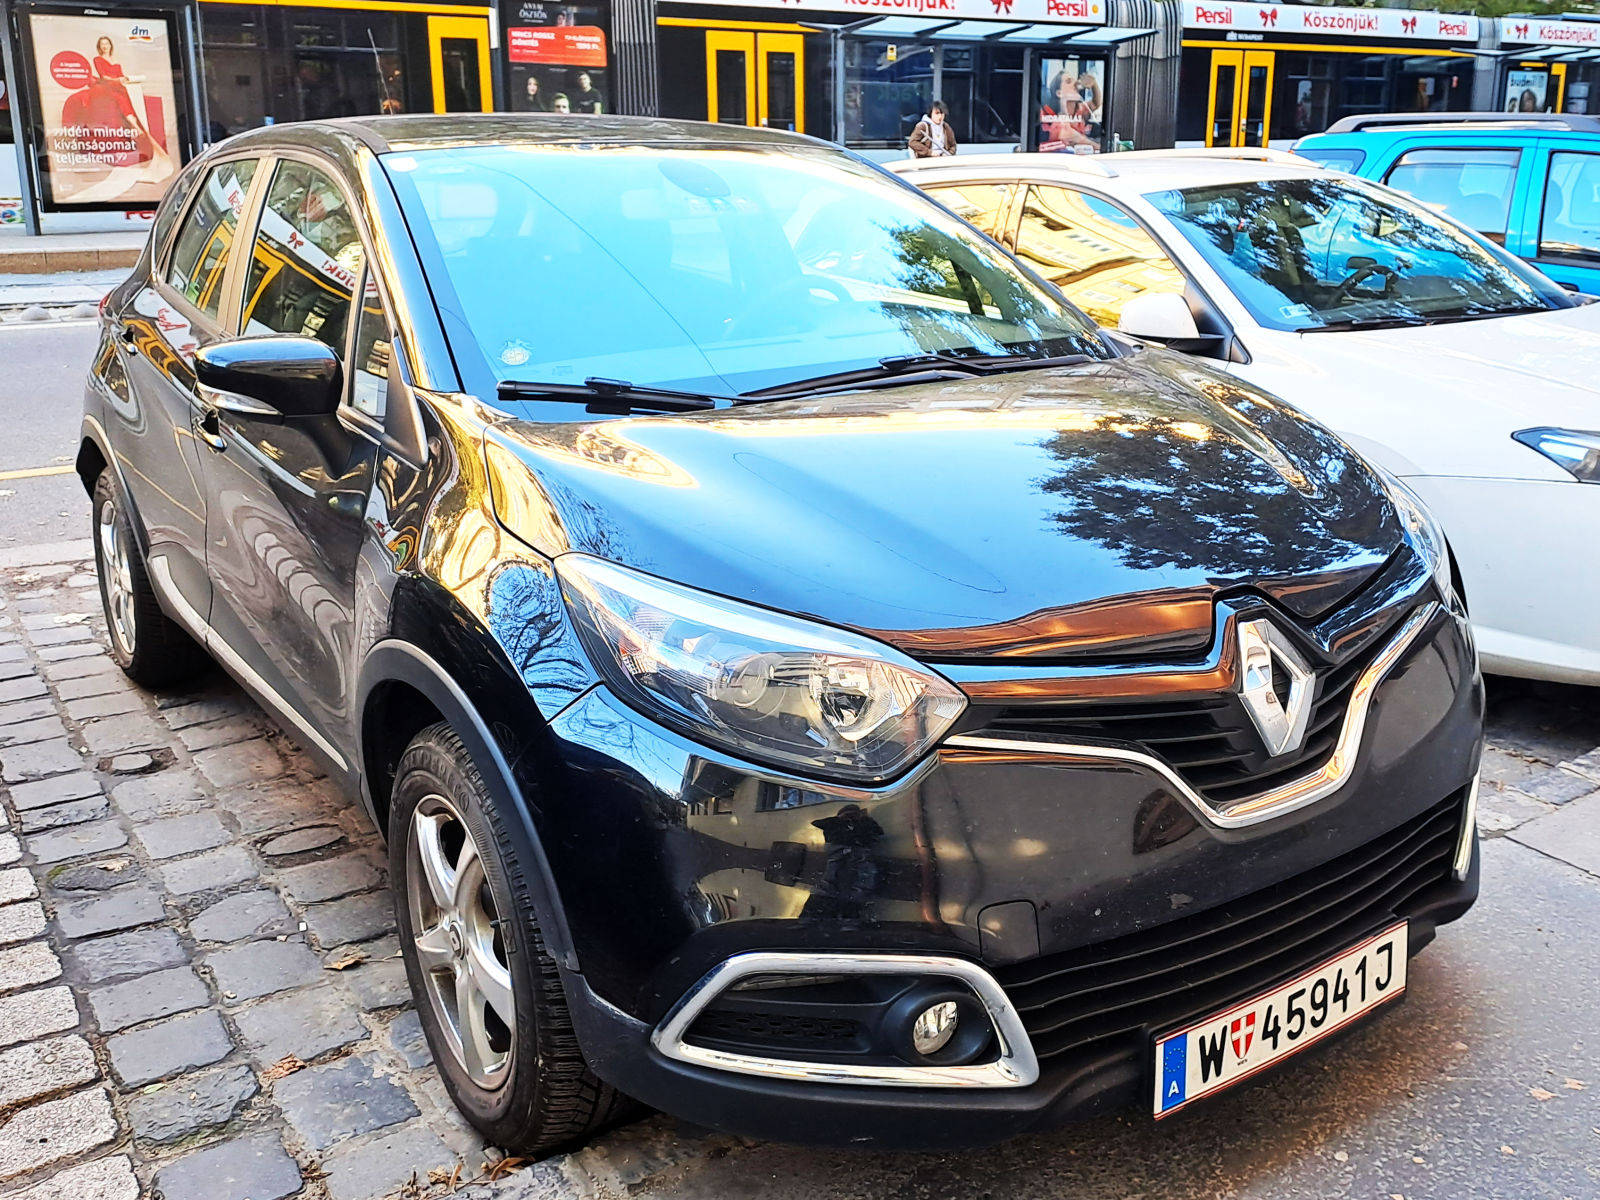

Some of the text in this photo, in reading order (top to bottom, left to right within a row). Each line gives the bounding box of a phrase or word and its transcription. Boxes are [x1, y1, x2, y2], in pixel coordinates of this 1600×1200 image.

[1047, 0, 1088, 17] Persil
[1195, 6, 1232, 25] Persil
[1303, 11, 1379, 33] Köszönjük!
[1438, 20, 1468, 36] Persil
[131, 26, 149, 36] dm
[1539, 24, 1597, 43] Köszönjük!
[93, 126, 138, 138] minden
[54, 139, 137, 152] kívánságomat
[1199, 941, 1393, 1083] W 45941J
[1168, 1080, 1180, 1098] A
